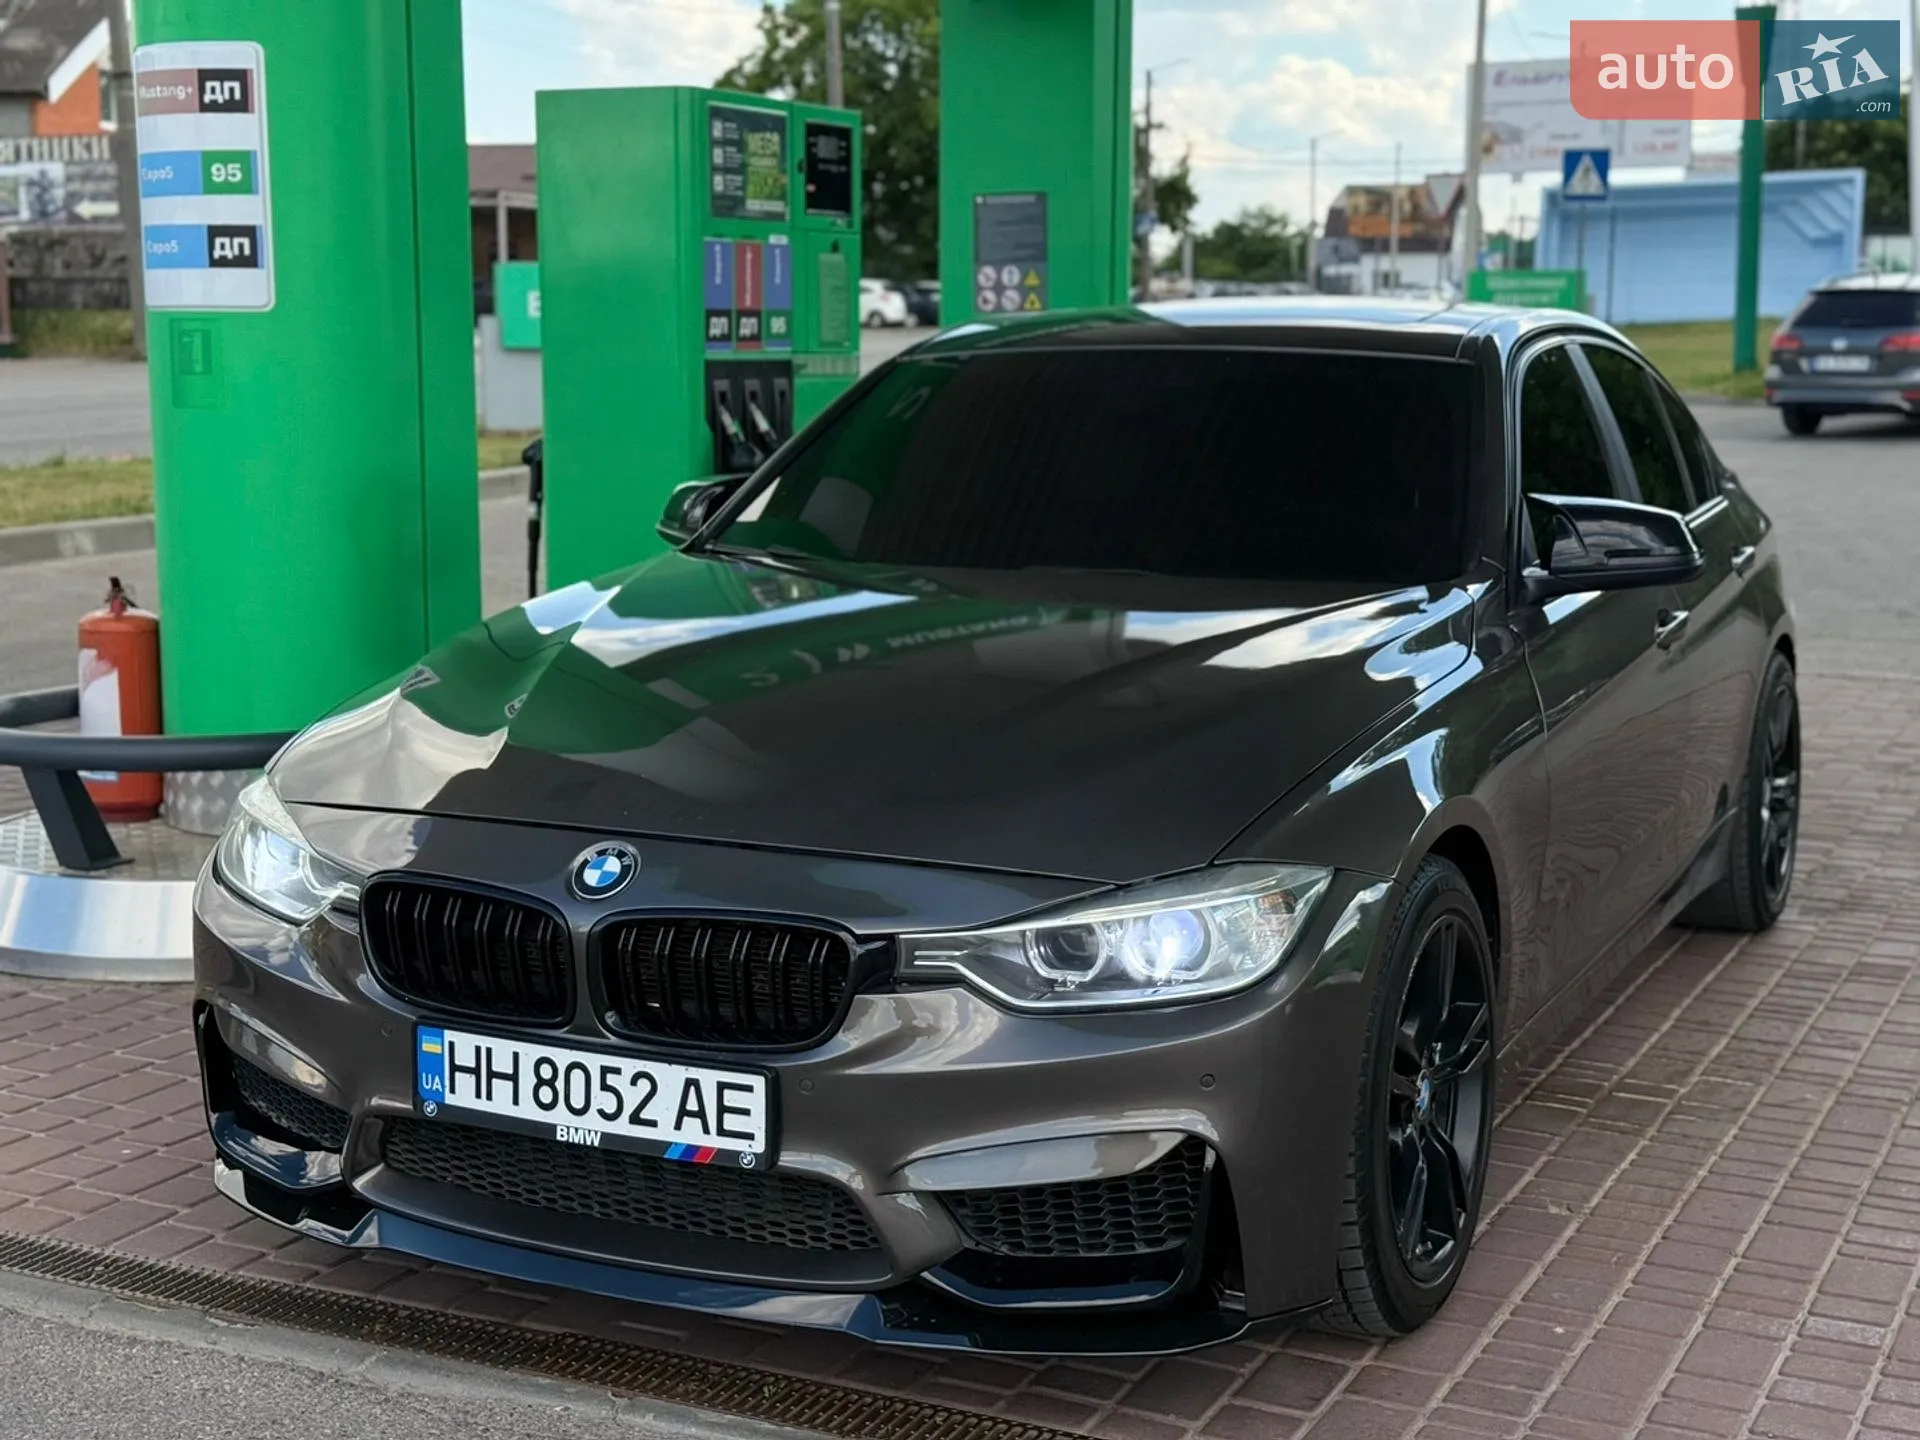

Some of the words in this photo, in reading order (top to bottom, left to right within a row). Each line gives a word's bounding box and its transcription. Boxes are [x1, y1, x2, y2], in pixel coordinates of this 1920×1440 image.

[203, 80, 241, 104] ДП
[210, 162, 242, 183] 95
[213, 237, 250, 260] ДП
[770, 316, 787, 335] 95
[422, 1072, 443, 1092] UA
[448, 1040, 519, 1106] HH
[532, 1056, 658, 1128] 8052
[673, 1076, 755, 1141] AE
[556, 1125, 601, 1147] BMW
